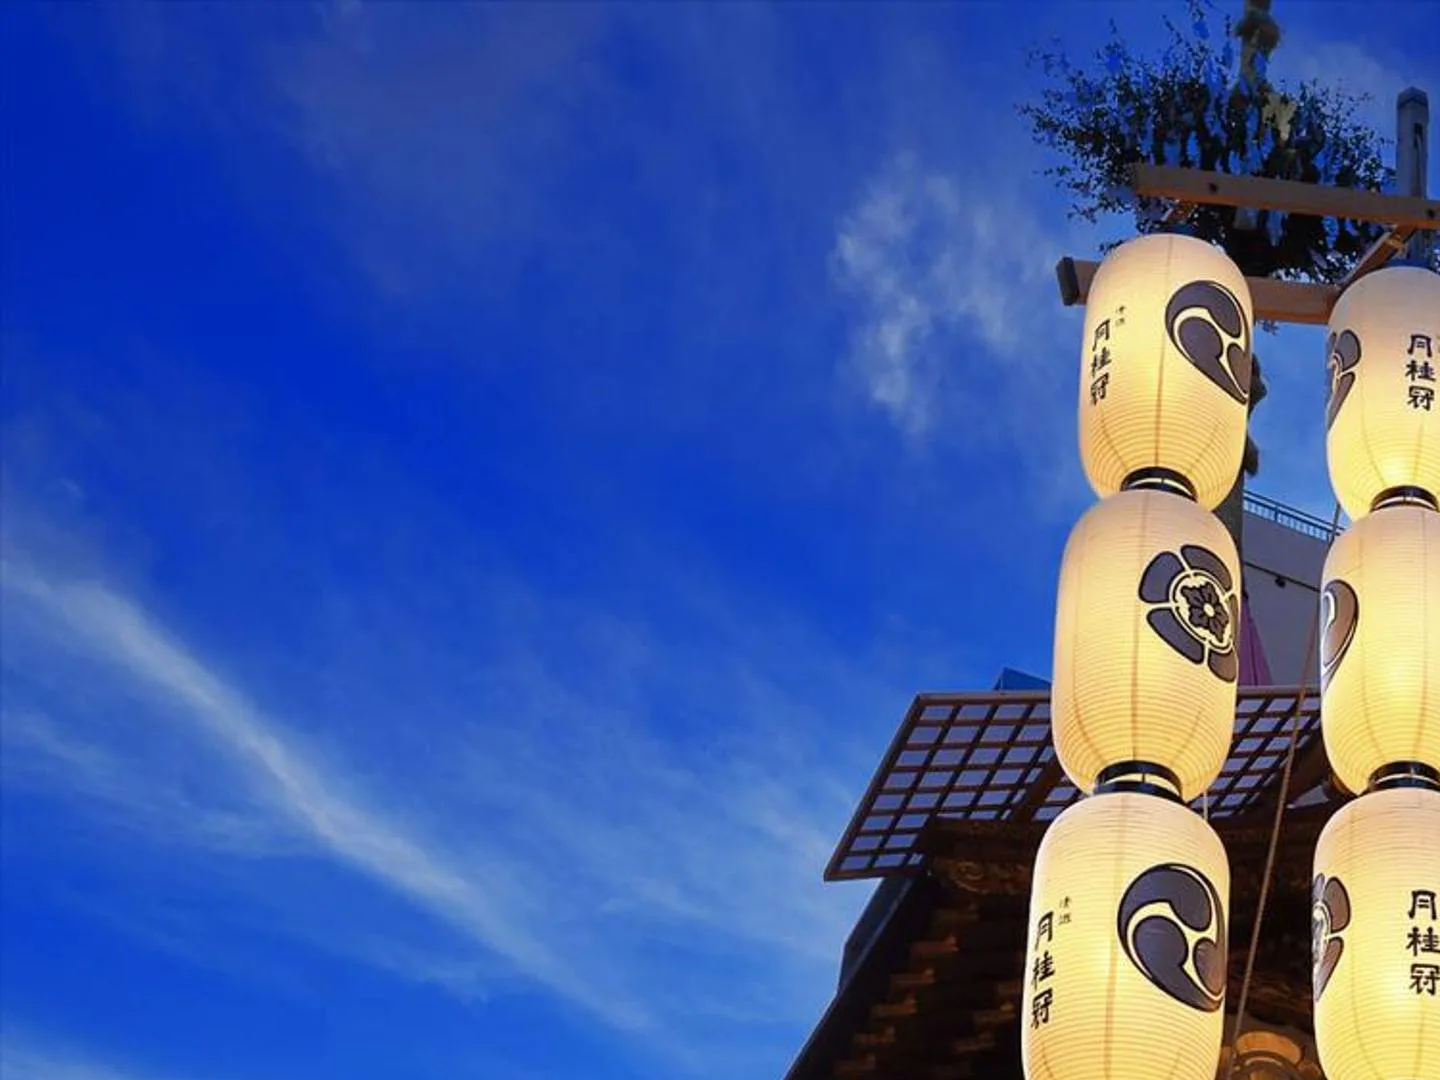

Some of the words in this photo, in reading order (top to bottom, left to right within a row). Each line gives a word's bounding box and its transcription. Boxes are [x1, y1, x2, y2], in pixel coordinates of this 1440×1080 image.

[1405, 333, 1436, 411] 月桂冠
[1031, 910, 1055, 1029] 月桂冠
